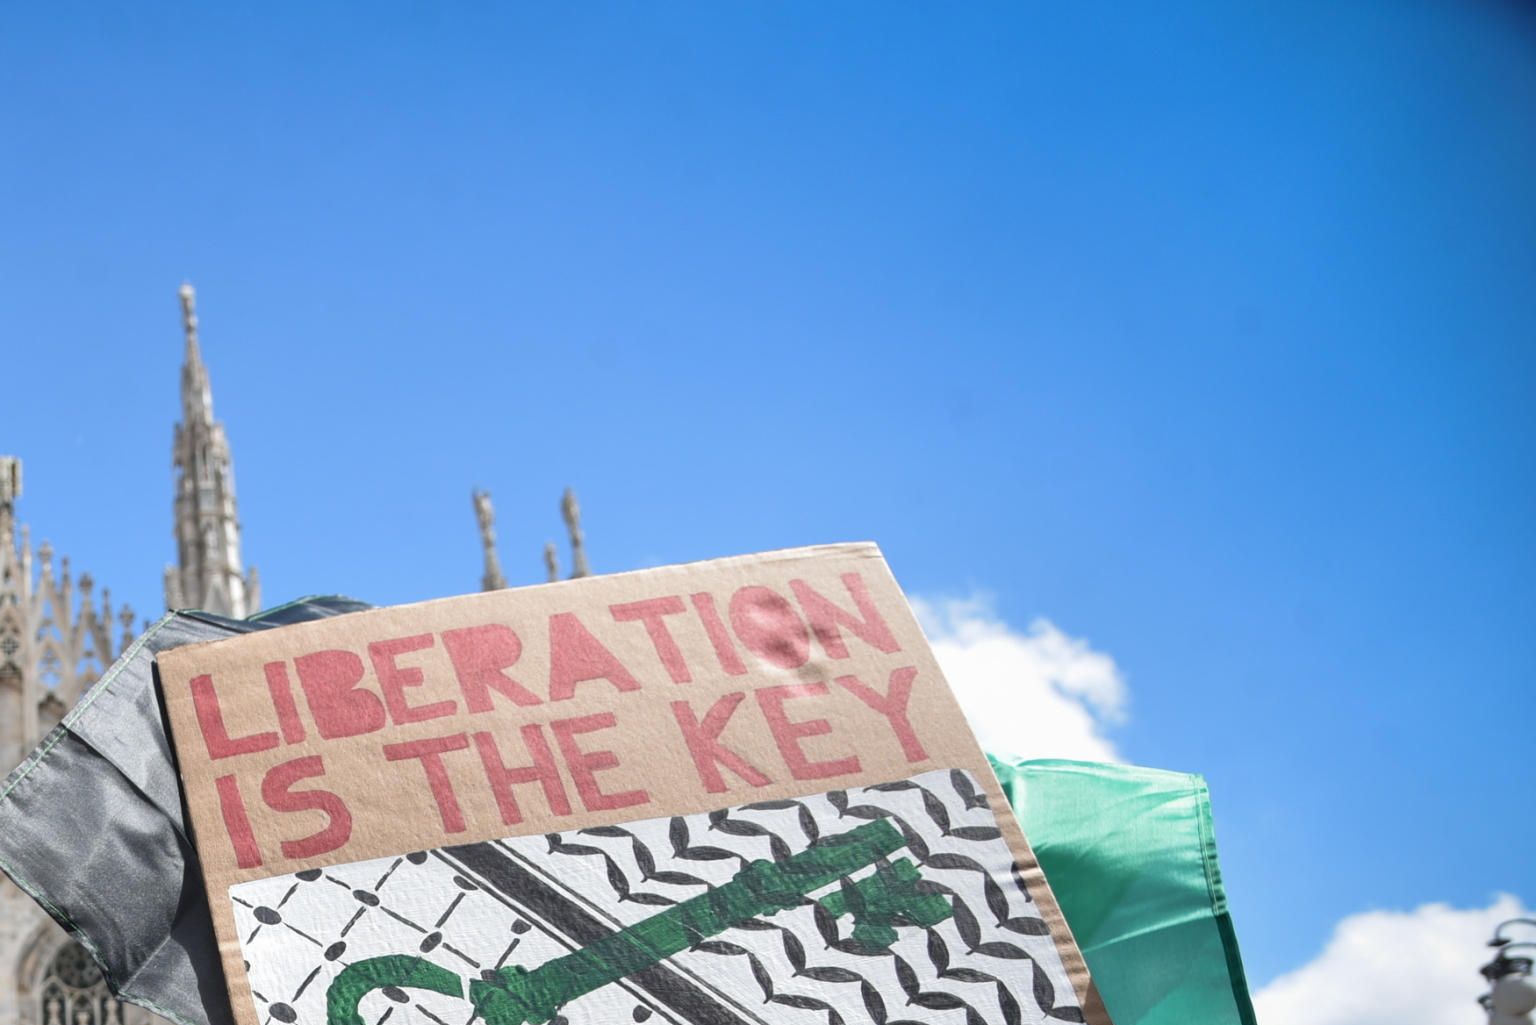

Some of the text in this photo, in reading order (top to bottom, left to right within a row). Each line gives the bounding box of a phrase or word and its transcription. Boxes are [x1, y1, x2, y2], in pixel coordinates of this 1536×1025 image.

[189, 573, 899, 761] LIBERATION
[215, 667, 928, 870] IS THE KEY
